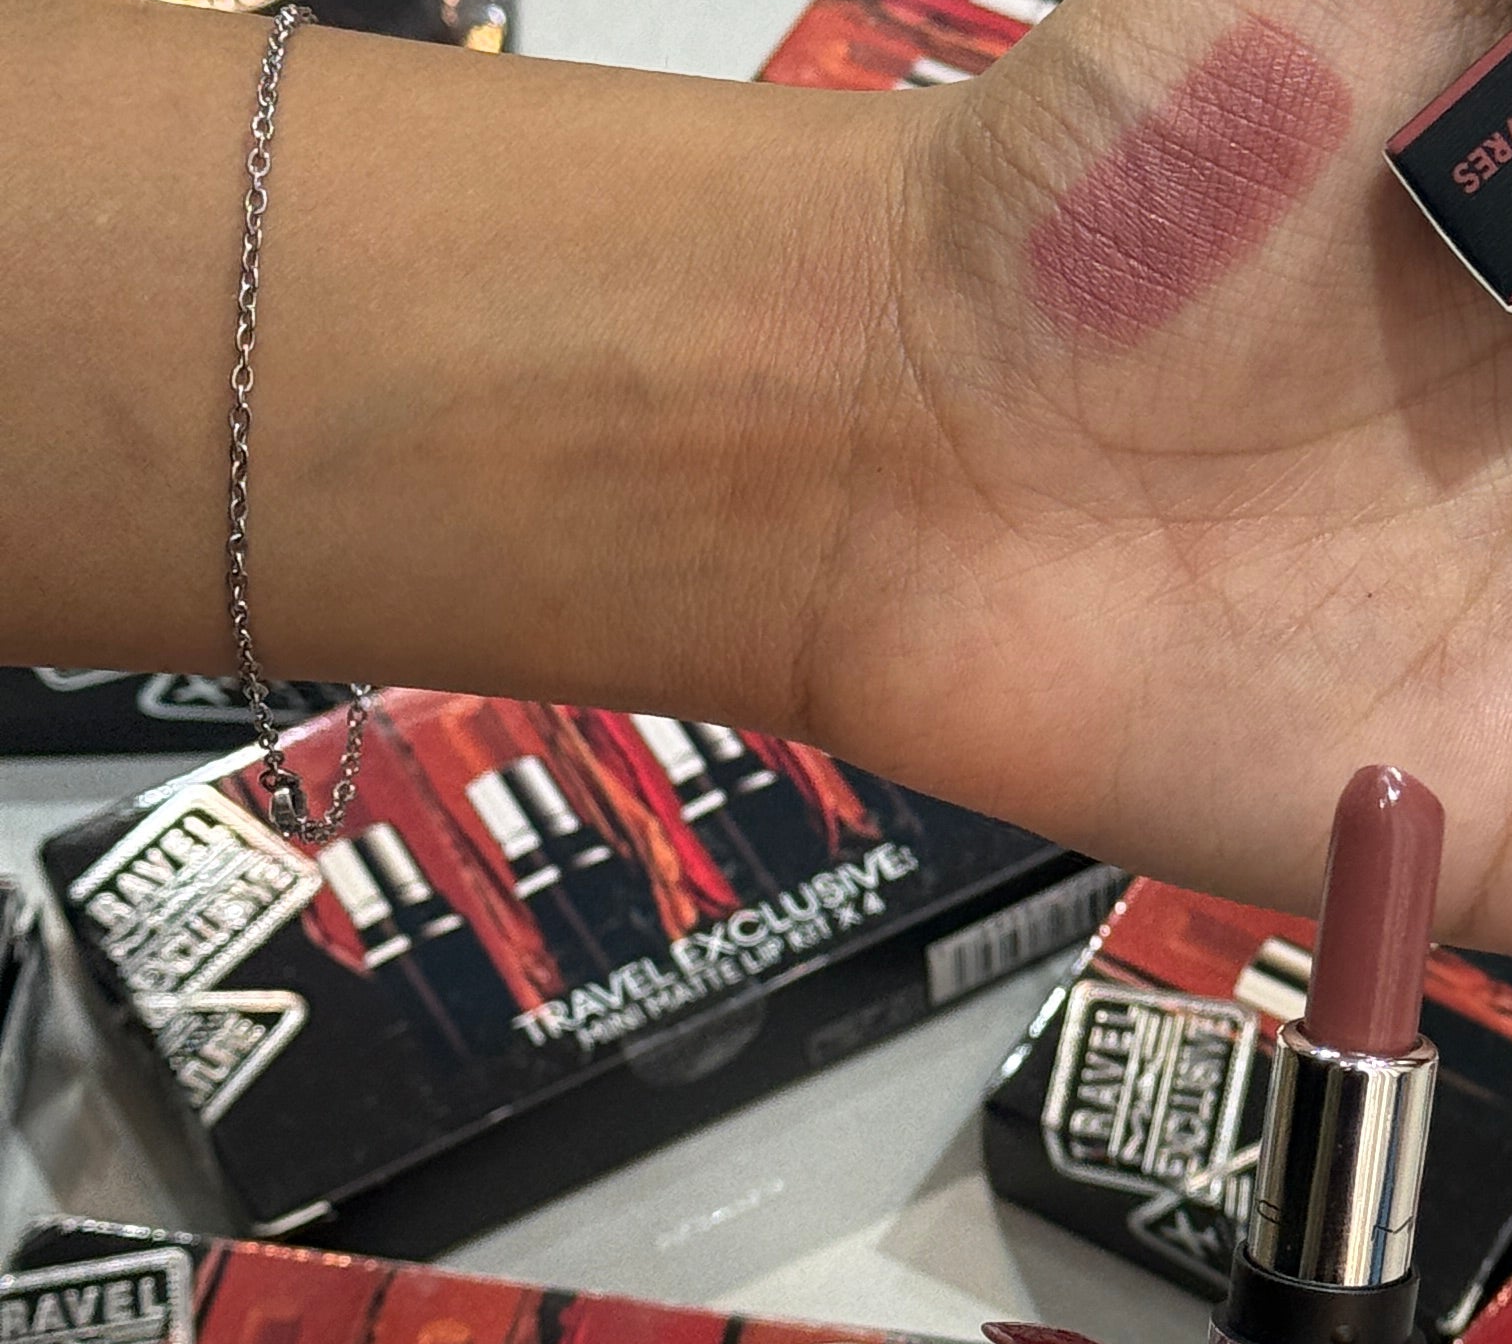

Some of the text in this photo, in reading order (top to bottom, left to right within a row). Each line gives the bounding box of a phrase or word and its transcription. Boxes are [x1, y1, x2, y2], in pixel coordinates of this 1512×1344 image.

[76, 800, 234, 937] RAVEL
[508, 947, 683, 1053] TRAVEL
[573, 998, 650, 1053] MINI
[641, 954, 746, 1021] MATTE
[738, 933, 790, 976] LIP
[784, 913, 834, 954] KIT
[857, 887, 888, 920] 4
[1062, 998, 1138, 1165] TRAVEL
[0, 1269, 171, 1343] RAVEL
